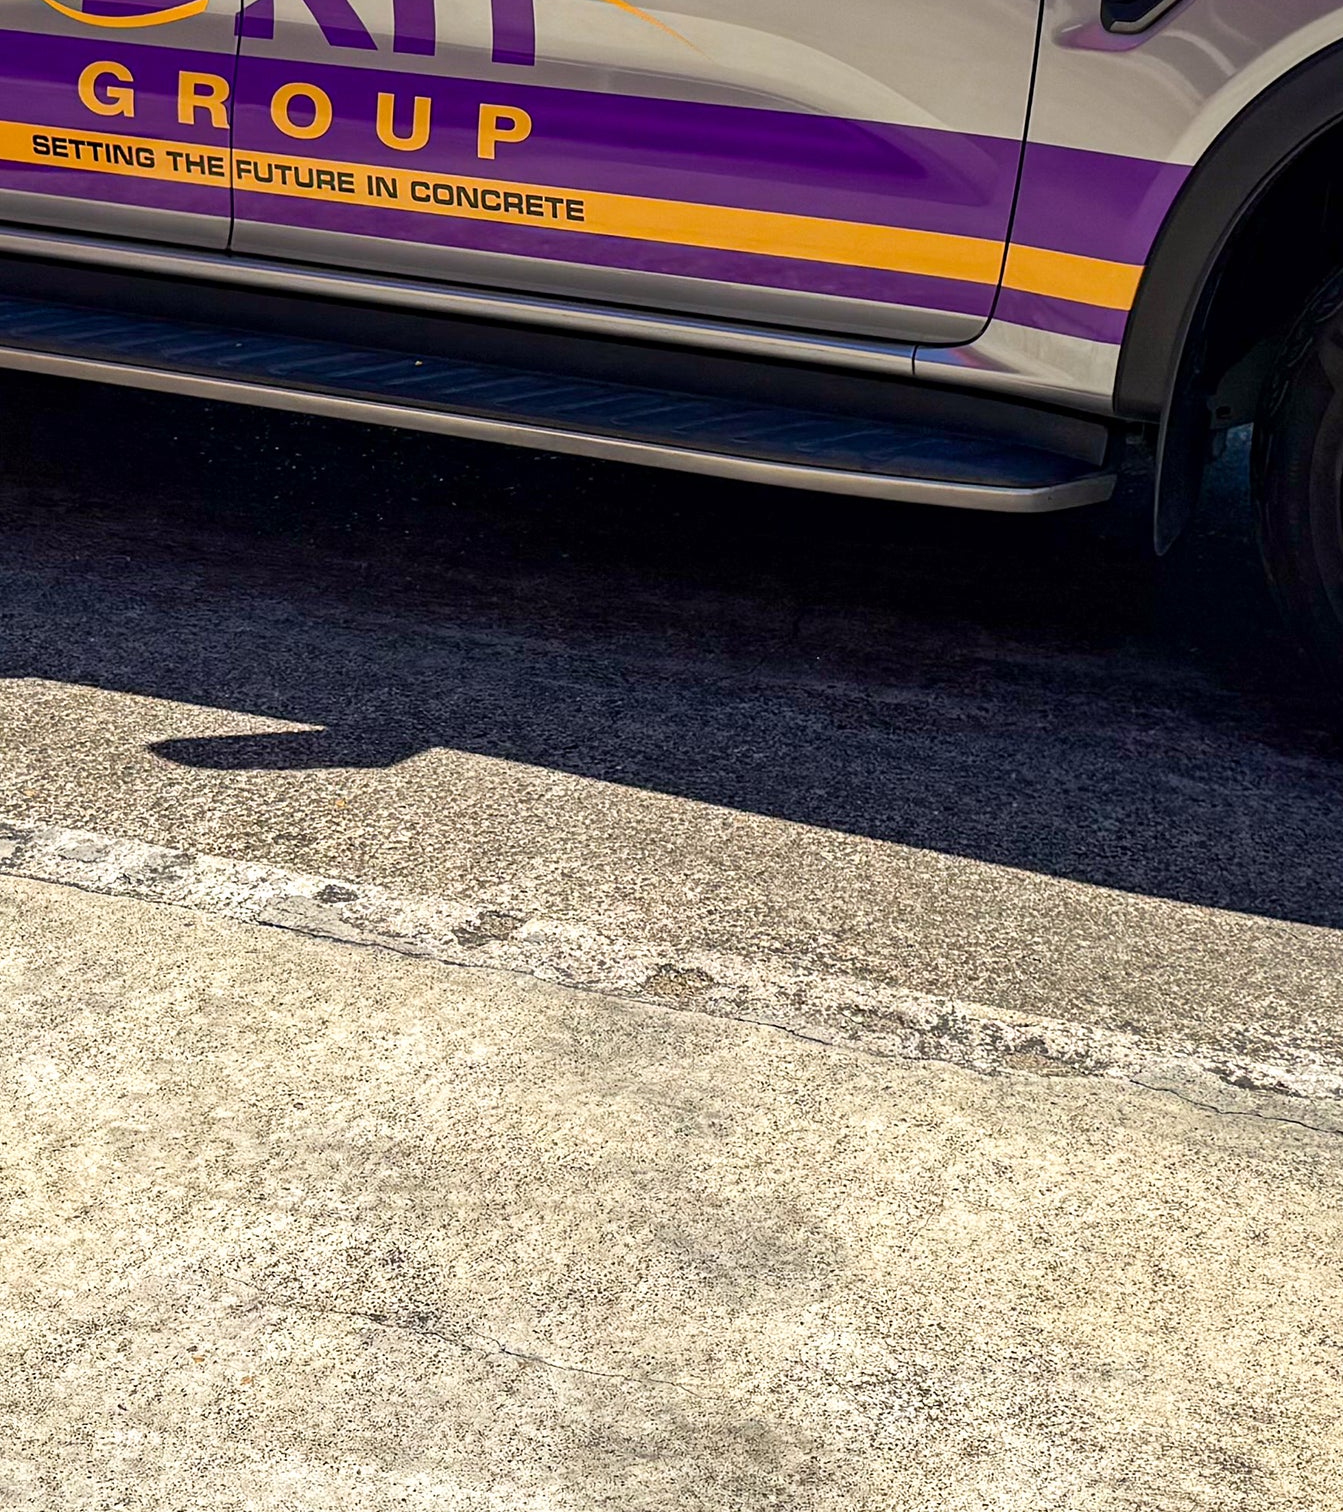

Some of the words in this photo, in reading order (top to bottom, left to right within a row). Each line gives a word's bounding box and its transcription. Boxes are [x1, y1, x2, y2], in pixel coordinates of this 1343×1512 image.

[77, 61, 534, 161] GROUP
[31, 133, 156, 170] SETTING
[165, 149, 227, 179] THE
[235, 158, 356, 196] FUTURE
[366, 173, 399, 198] IN
[410, 180, 586, 223] CONCRETE
